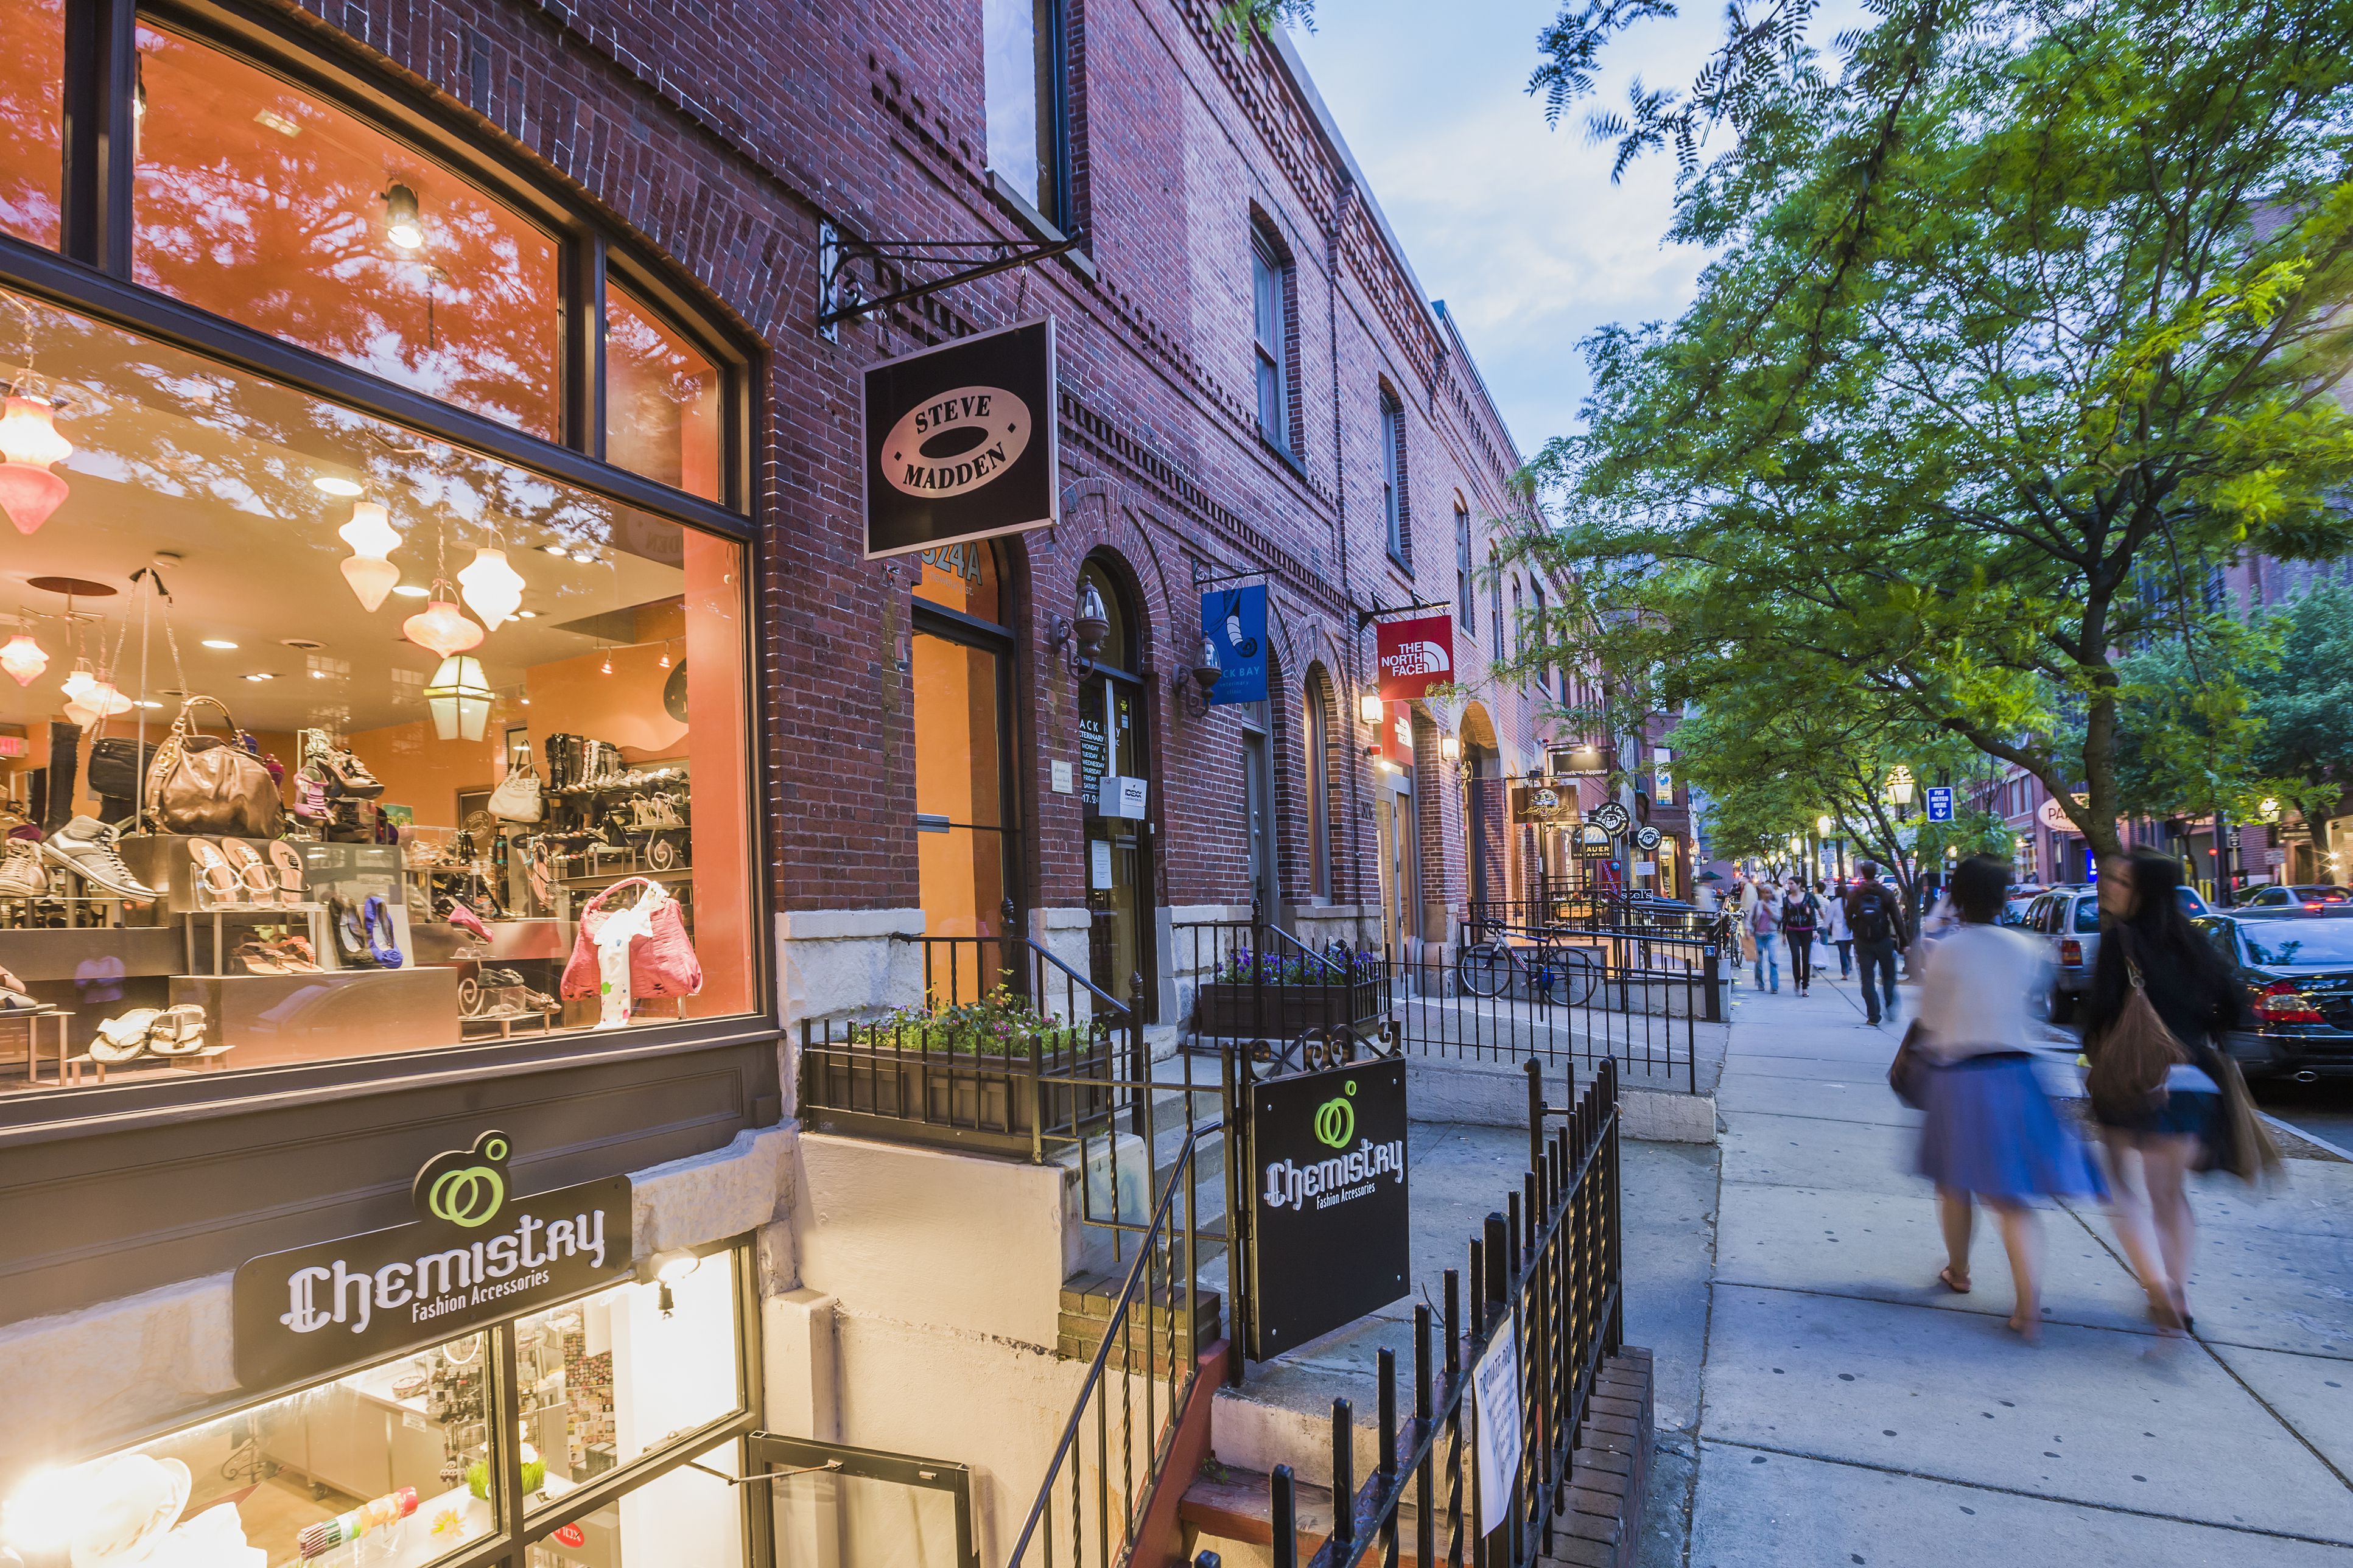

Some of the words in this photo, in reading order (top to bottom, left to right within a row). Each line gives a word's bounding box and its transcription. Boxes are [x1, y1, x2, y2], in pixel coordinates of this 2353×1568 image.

[915, 395, 991, 435] STEVE
[903, 442, 1006, 489] MADDEN
[1398, 641, 1423, 654] THE
[1381, 652, 1423, 667] NORTH
[1222, 668, 1236, 678] CK
[1240, 666, 1260, 677] BAY
[1392, 663, 1423, 677] FACE
[1079, 718, 1099, 733] ACK
[1079, 730, 1104, 743] ETERINARY
[1082, 743, 1099, 752] MONDAY
[1082, 751, 1098, 760] TUESDAY
[1082, 759, 1105, 769] WEDNESDAY
[1082, 766, 1102, 776] THURSDAY
[1263, 1138, 1403, 1211] Chemistry
[1316, 1192, 1339, 1210] Fashion
[1341, 1181, 1375, 1203] Accessories
[279, 1209, 605, 1334] Chemistry
[412, 1290, 467, 1323] Fashion
[471, 1269, 550, 1305] Accessories
[1479, 1354, 1501, 1402] PRIVATE
